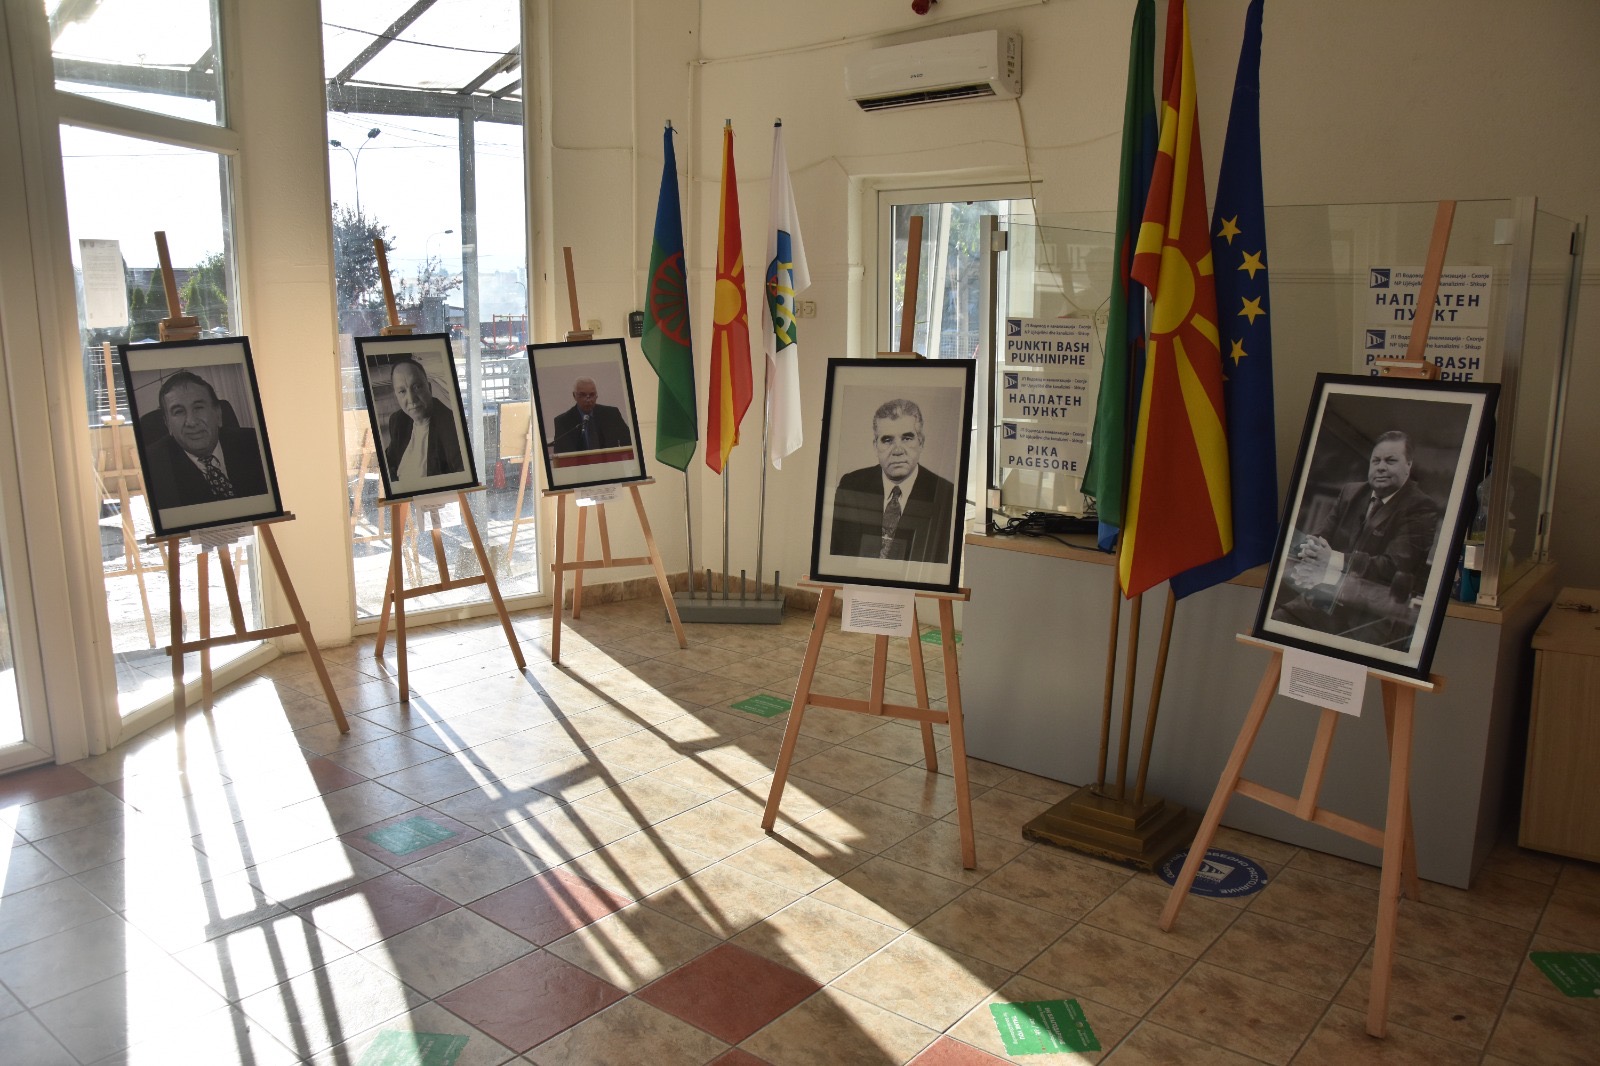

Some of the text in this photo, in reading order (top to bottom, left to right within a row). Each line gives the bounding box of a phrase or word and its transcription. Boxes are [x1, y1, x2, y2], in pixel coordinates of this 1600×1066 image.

[1376, 293, 1479, 307] НАПАТЕН
[1394, 309, 1458, 321] ПУКТ
[1008, 340, 1089, 353] PUNKTI BASH
[1011, 352, 1086, 365] PUKHINIPHE
[1434, 356, 1480, 370] BASH
[1009, 393, 1082, 406] НАПЛАТЕН
[1023, 406, 1067, 417] ПУНКТ
[1027, 444, 1058, 457] PIKA
[1008, 455, 1077, 471] PAGESORE
